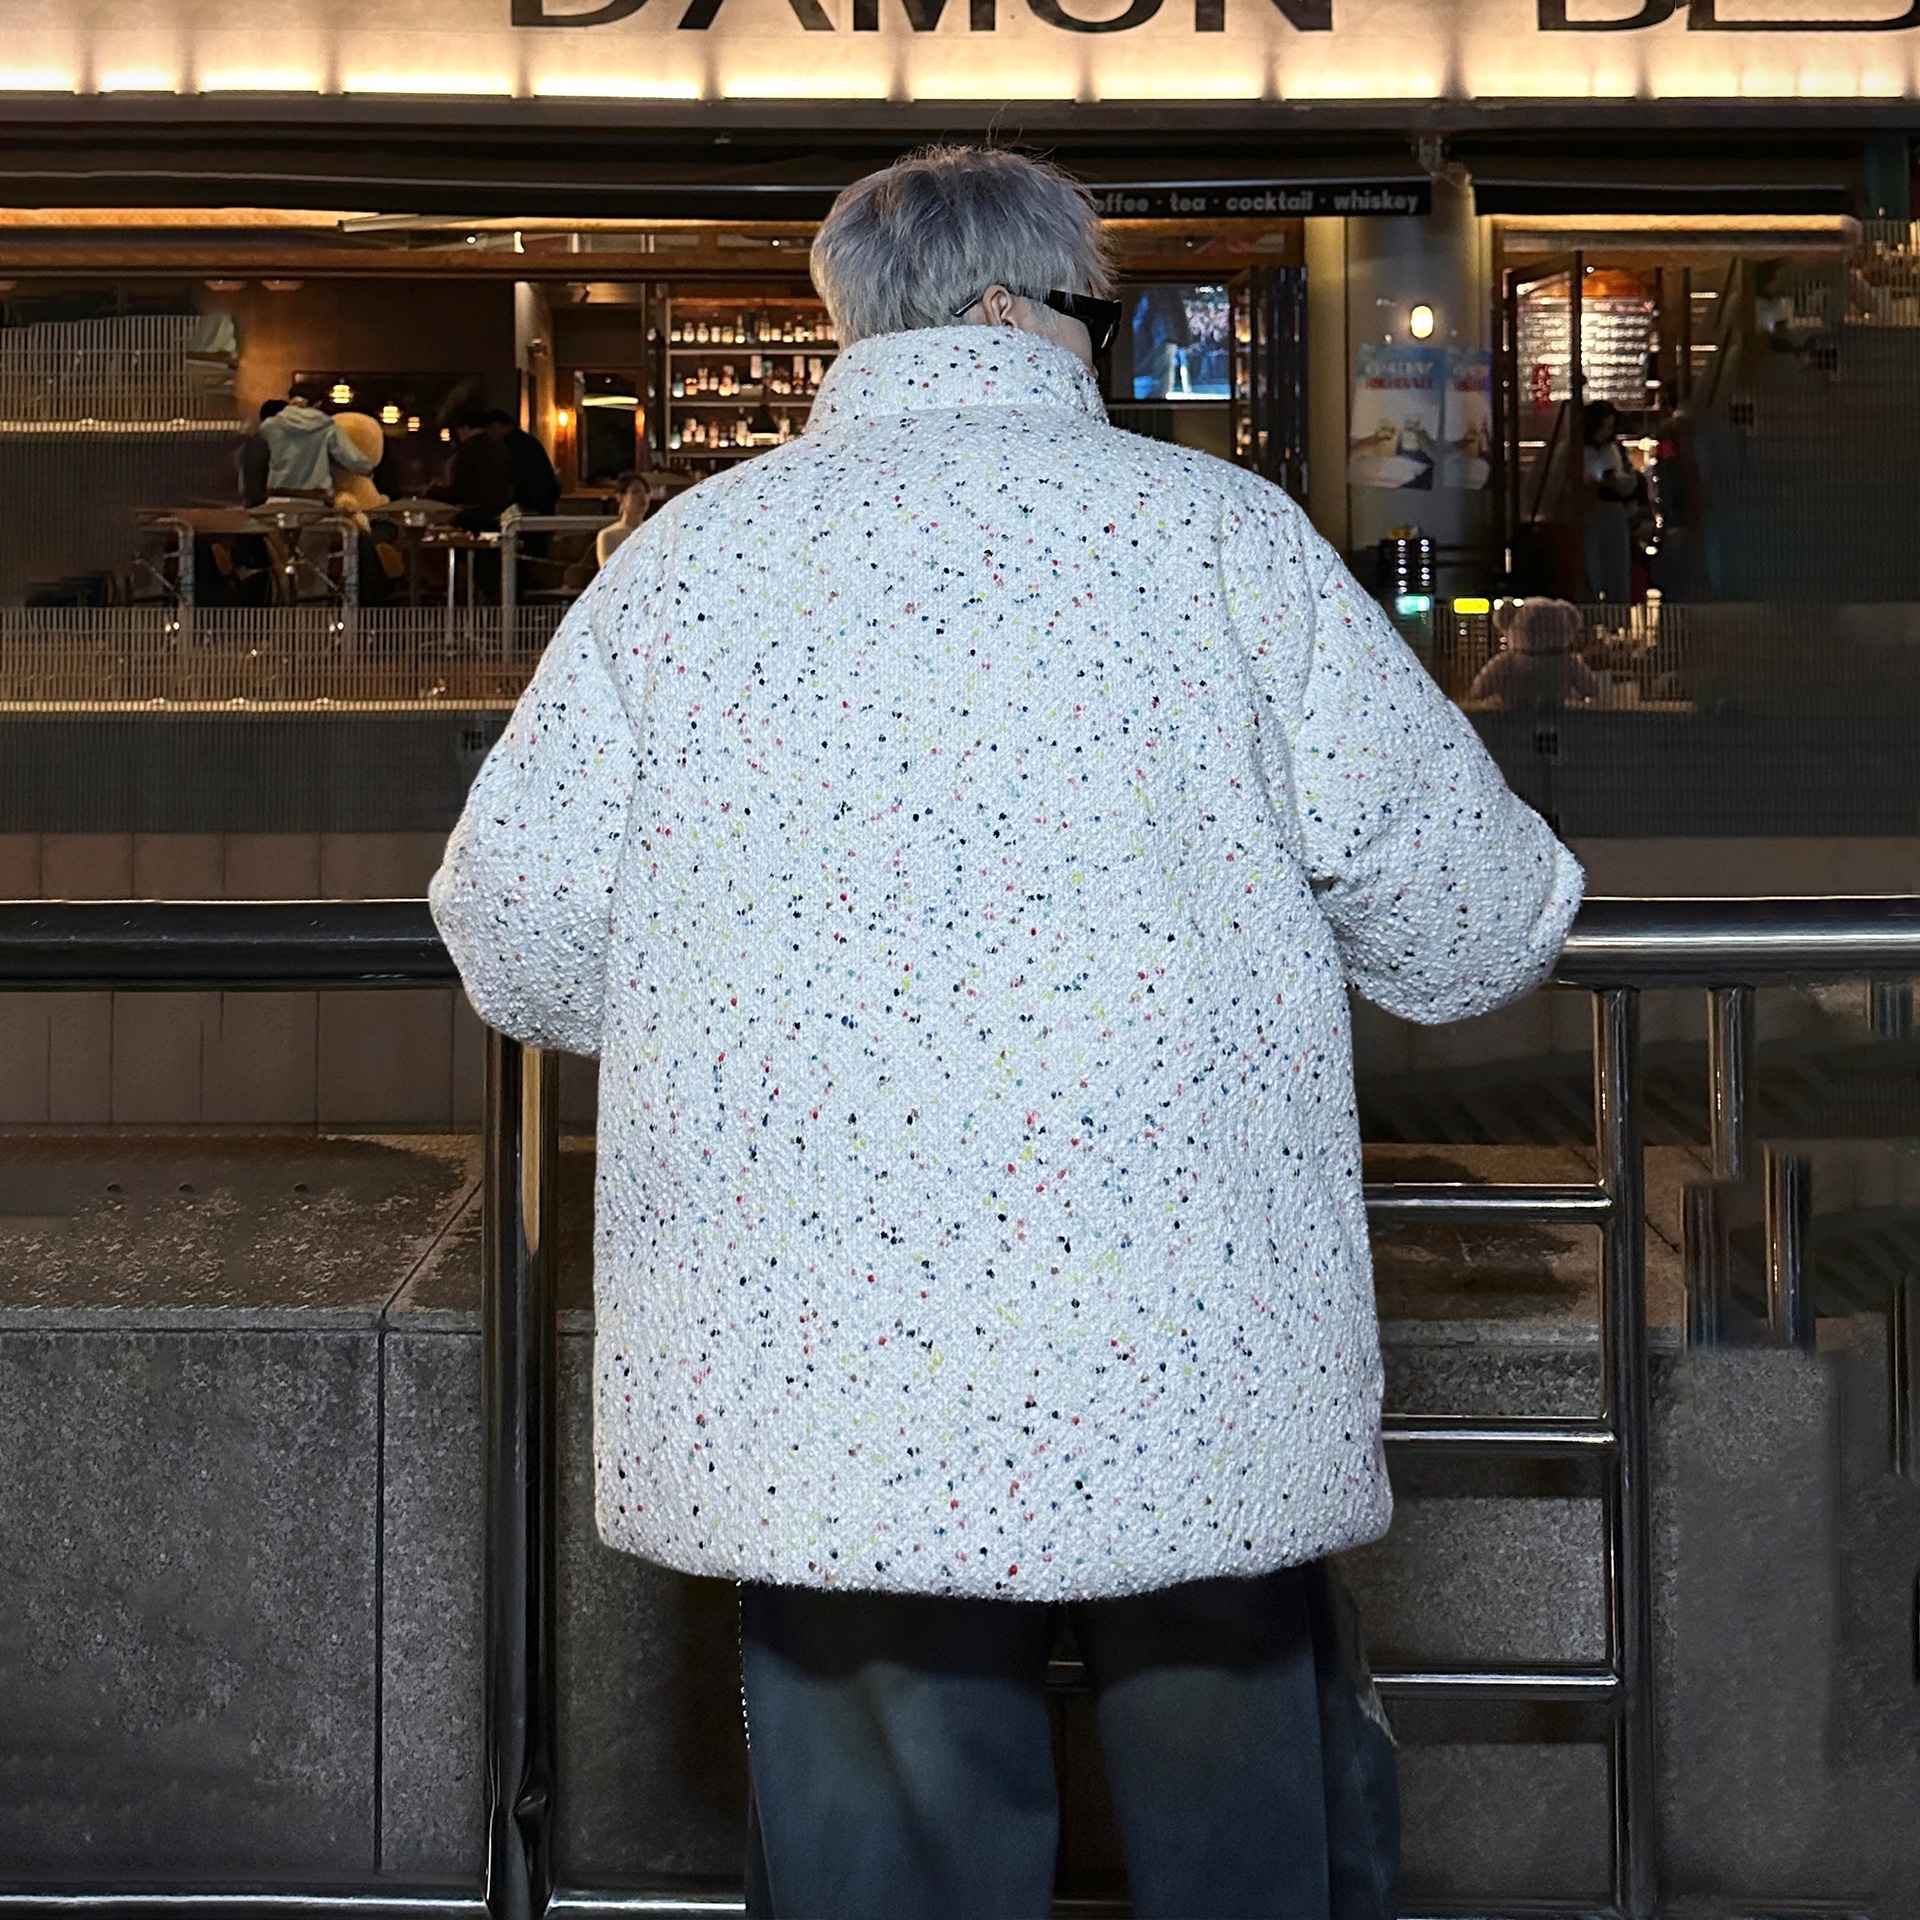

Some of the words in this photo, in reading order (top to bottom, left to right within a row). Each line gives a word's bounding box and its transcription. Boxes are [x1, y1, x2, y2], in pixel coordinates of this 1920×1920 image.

[1095, 192, 1149, 213] offee
[1170, 191, 1206, 211] tea
[1225, 190, 1314, 212] cocktail
[1333, 188, 1418, 214] whiskey
